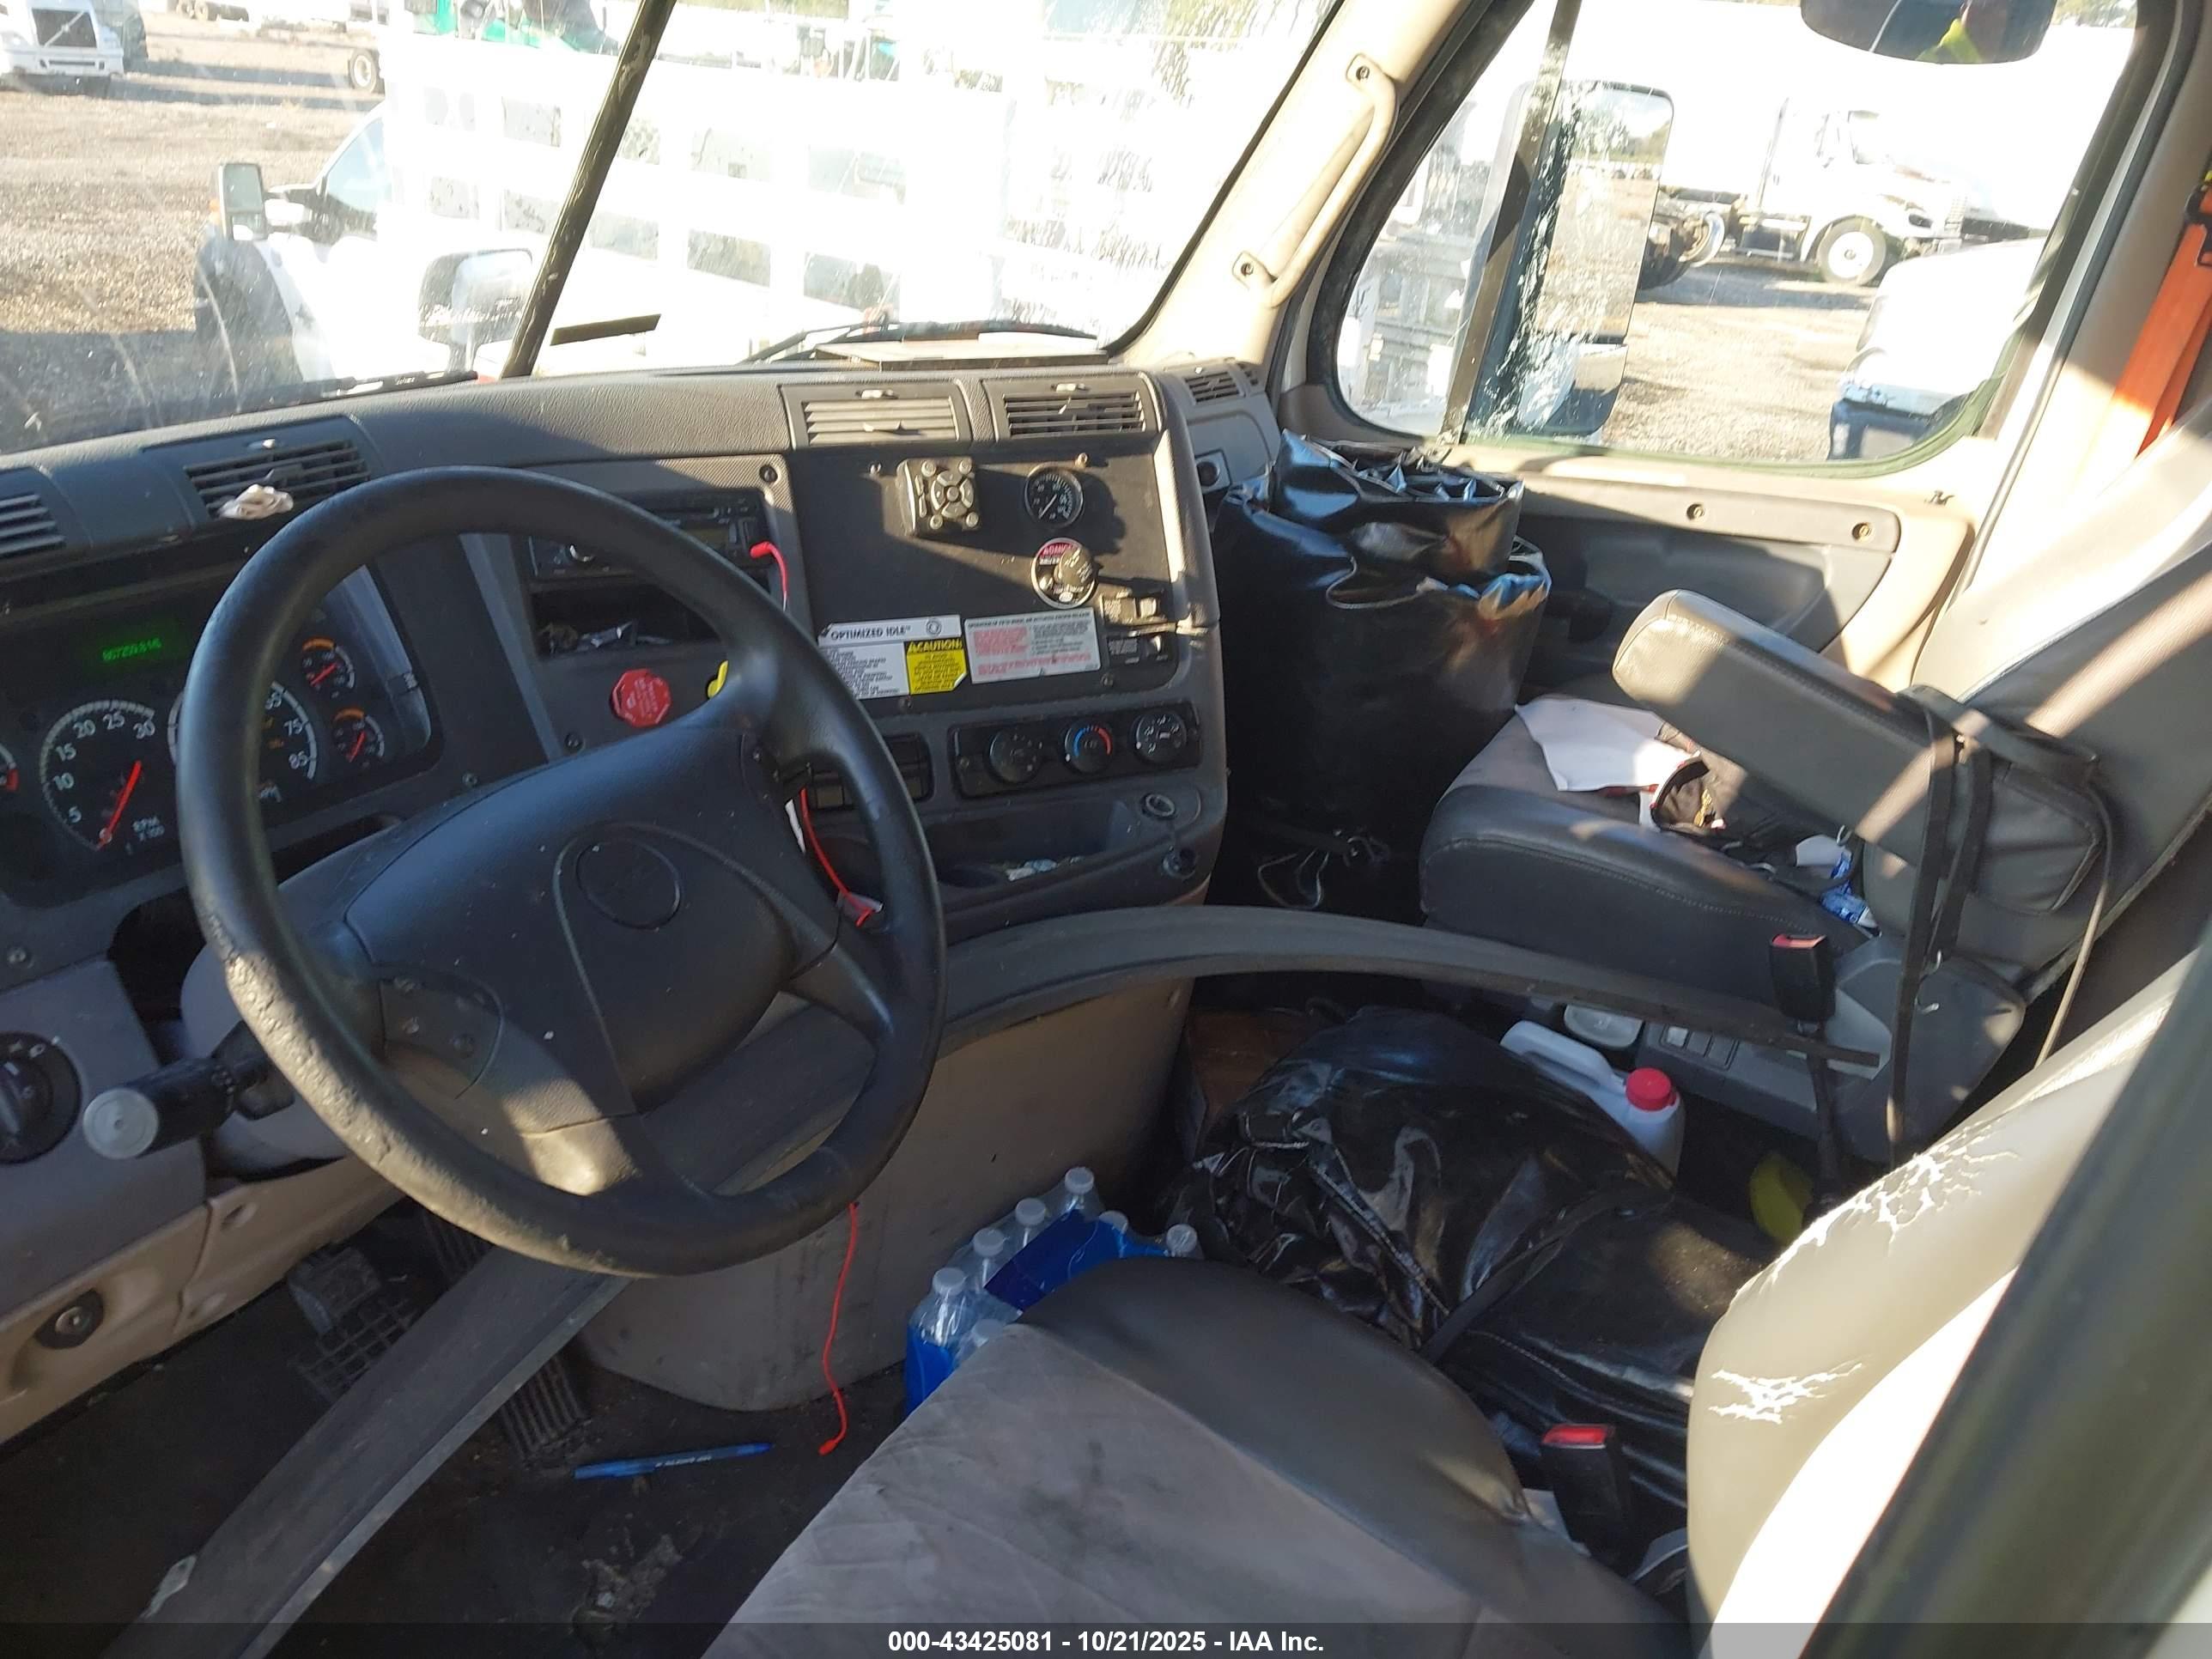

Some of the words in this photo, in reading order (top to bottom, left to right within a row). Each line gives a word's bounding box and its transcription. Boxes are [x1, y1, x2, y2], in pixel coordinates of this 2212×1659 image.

[830, 627, 884, 641] OPTIMIZED
[73, 720, 95, 738] 20
[102, 711, 125, 731] 25
[133, 720, 155, 739] 30
[283, 718, 303, 737] 75
[56, 743, 76, 762] 15
[289, 750, 309, 770] 85
[53, 773, 75, 791] 10
[69, 805, 82, 823] 5
